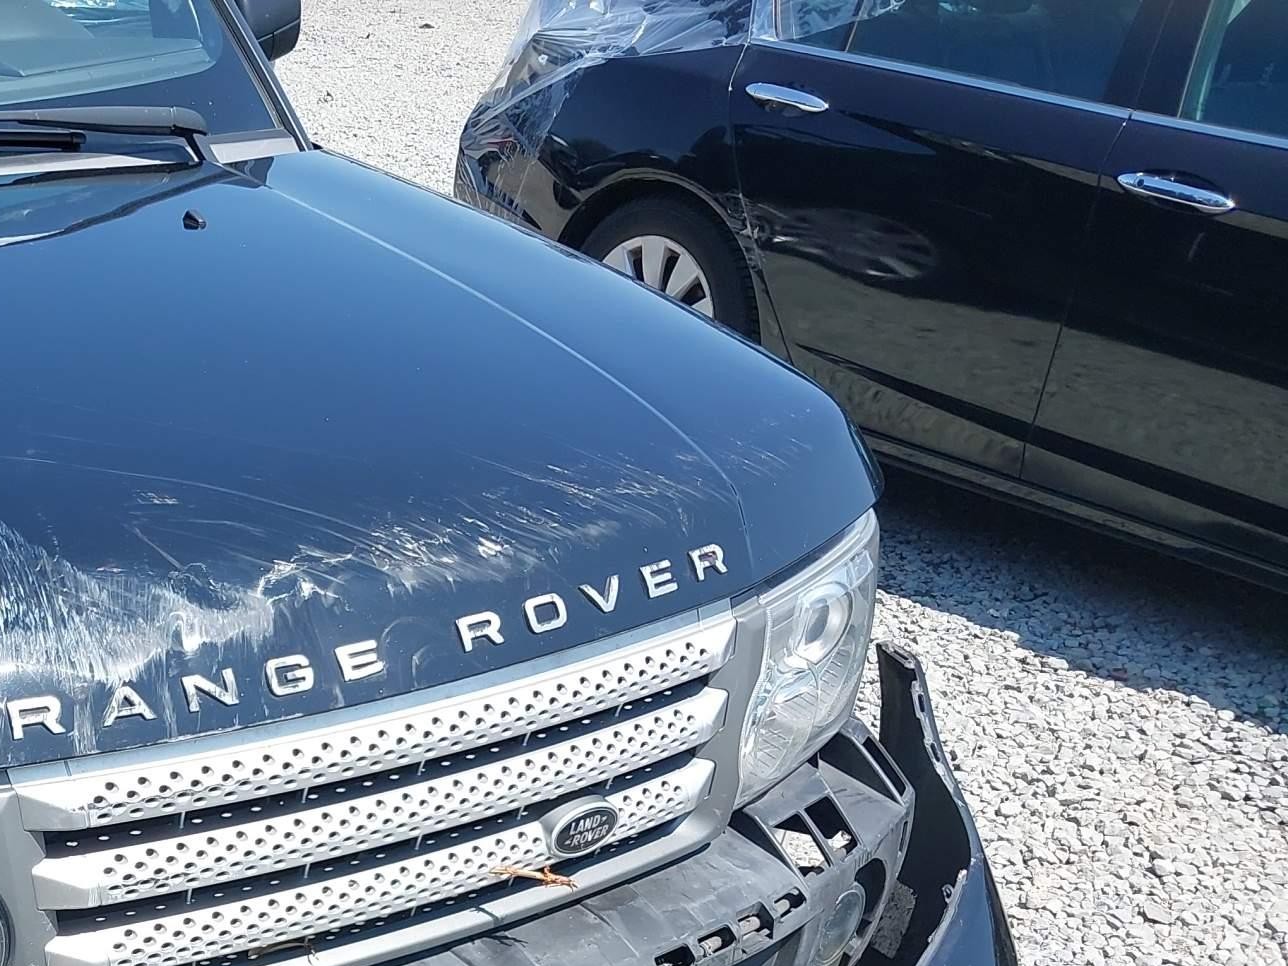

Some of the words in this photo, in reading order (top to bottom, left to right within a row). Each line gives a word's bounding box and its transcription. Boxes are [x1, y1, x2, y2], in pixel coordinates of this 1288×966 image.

[5, 639, 386, 740] RANGE
[455, 543, 729, 653] ROVER
[569, 814, 602, 836] LAND
[570, 824, 609, 848] ROVER
